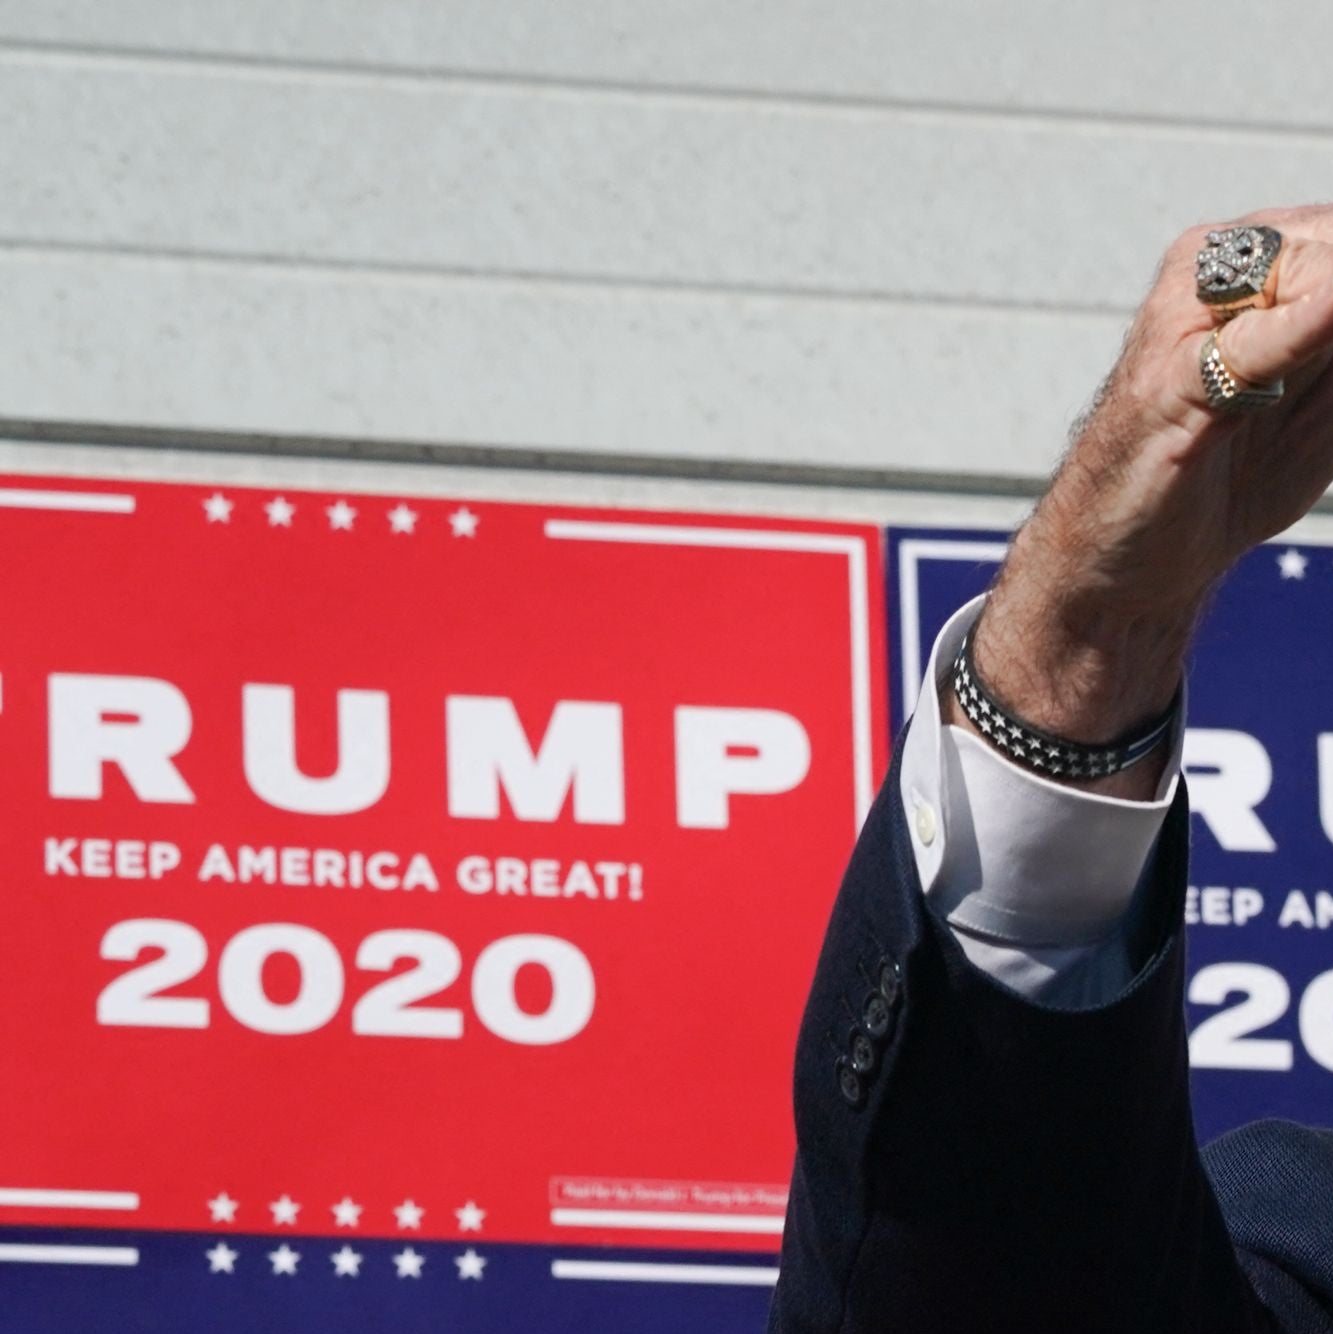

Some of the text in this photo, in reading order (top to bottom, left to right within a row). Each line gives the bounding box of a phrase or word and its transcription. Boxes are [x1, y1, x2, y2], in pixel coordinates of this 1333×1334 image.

[0, 672, 812, 830] RUMP
[44, 837, 644, 902] KEEP AMERICA GREAT!
[96, 917, 597, 1047] 2020
